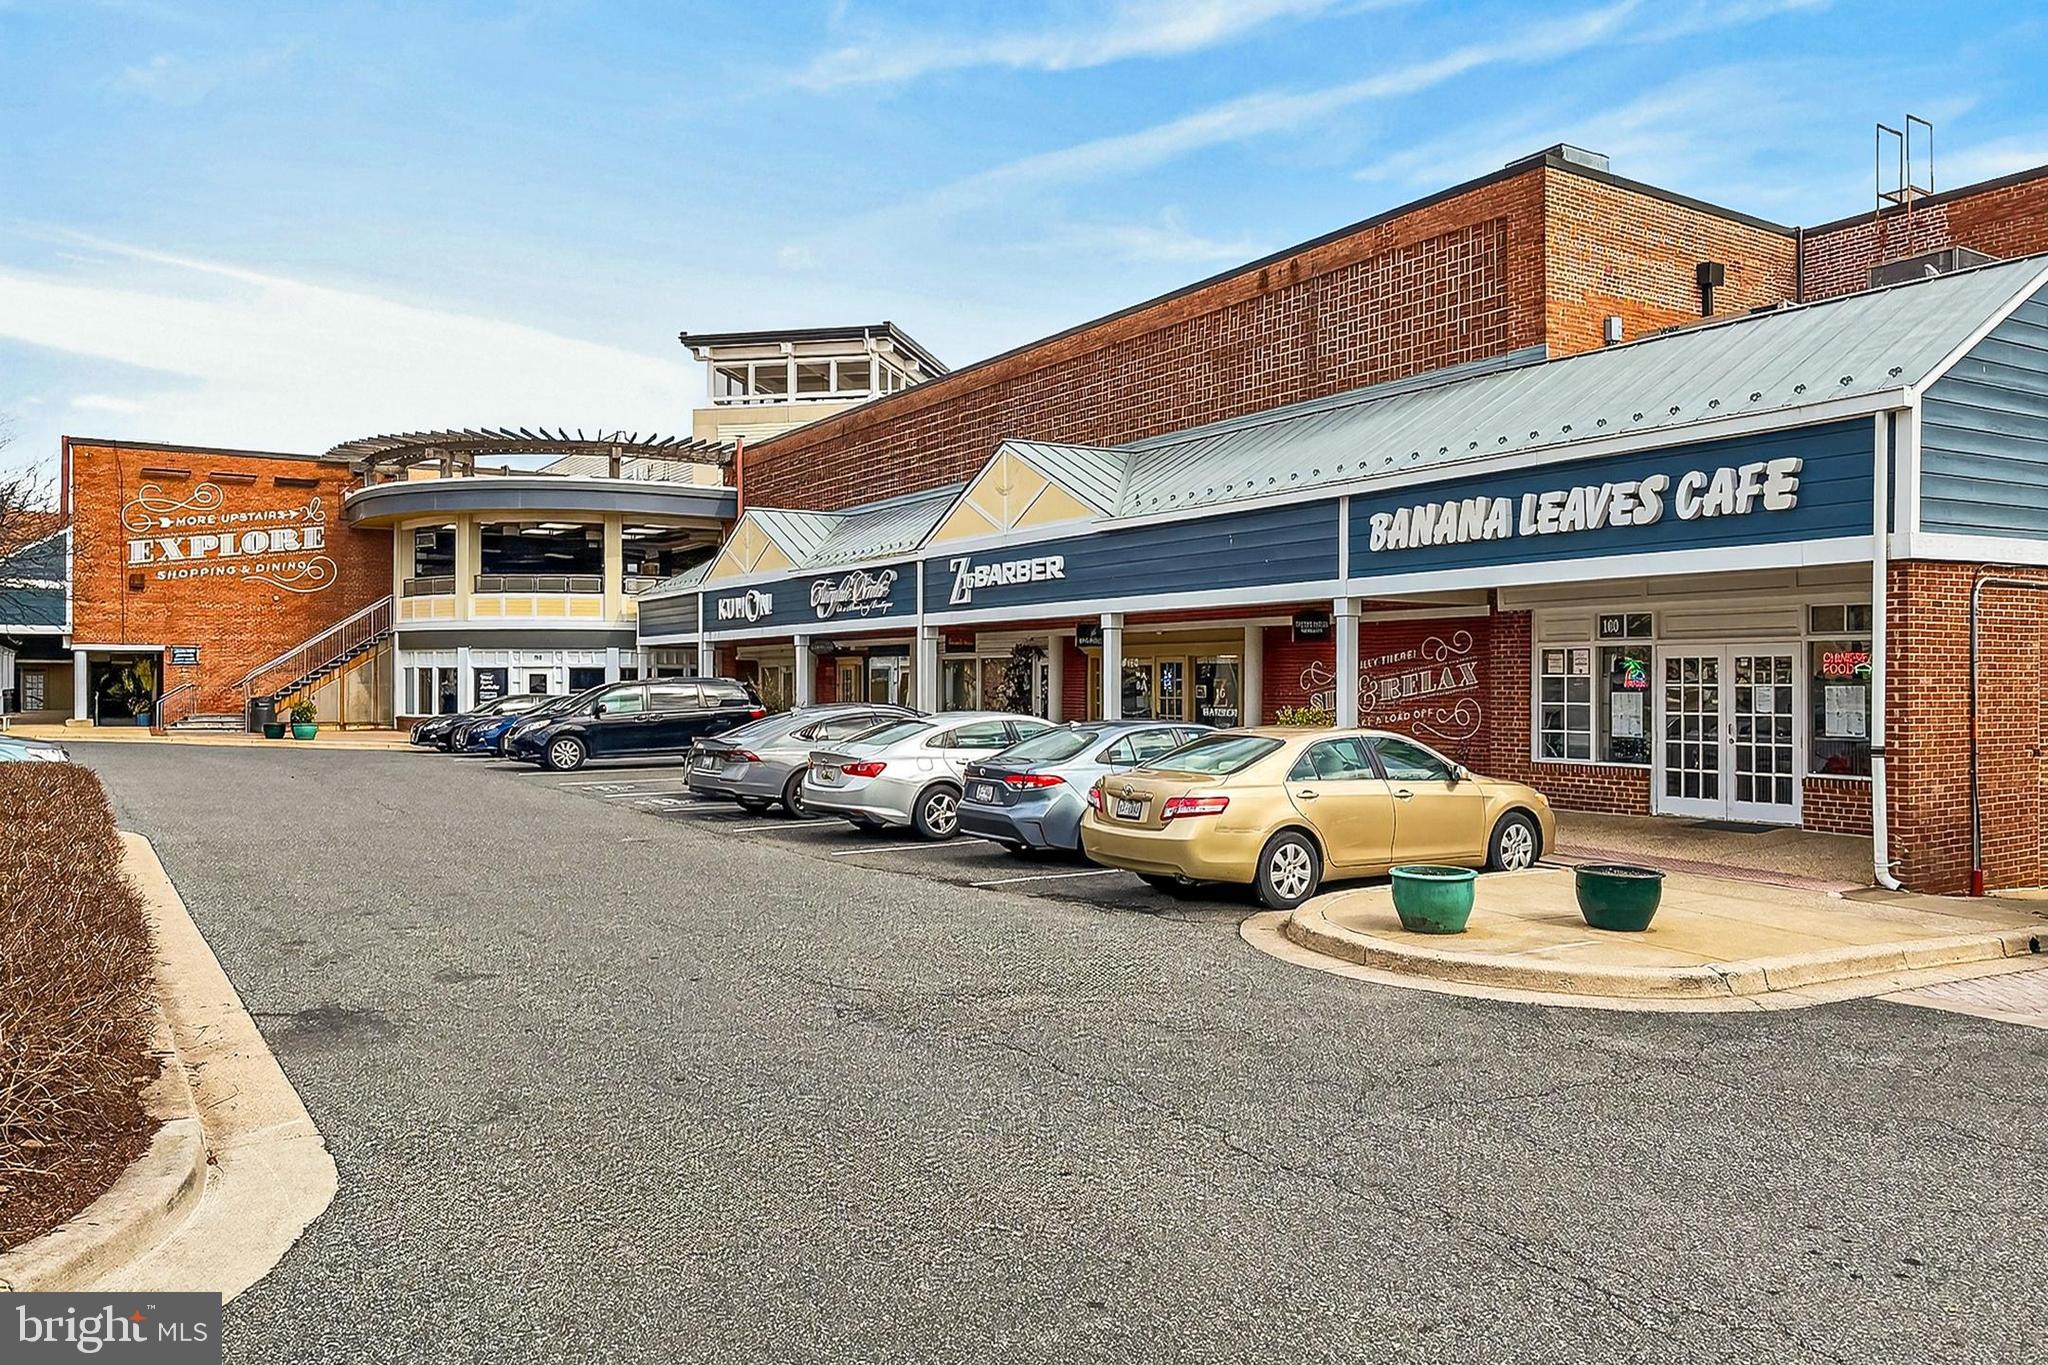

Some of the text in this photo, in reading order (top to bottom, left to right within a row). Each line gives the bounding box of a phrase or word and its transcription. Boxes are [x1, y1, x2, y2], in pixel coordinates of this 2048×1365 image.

[1369, 457, 1803, 552] BANANA LEAVES CAFE
[176, 511, 286, 527] MORE UPSTAIRS
[127, 526, 326, 565] EXPLORE
[156, 560, 307, 581] SHOPPING & DINING
[974, 556, 1066, 588] BARBER
[1823, 663, 1855, 675] FOOD
[1385, 711, 1411, 724] LOAD
